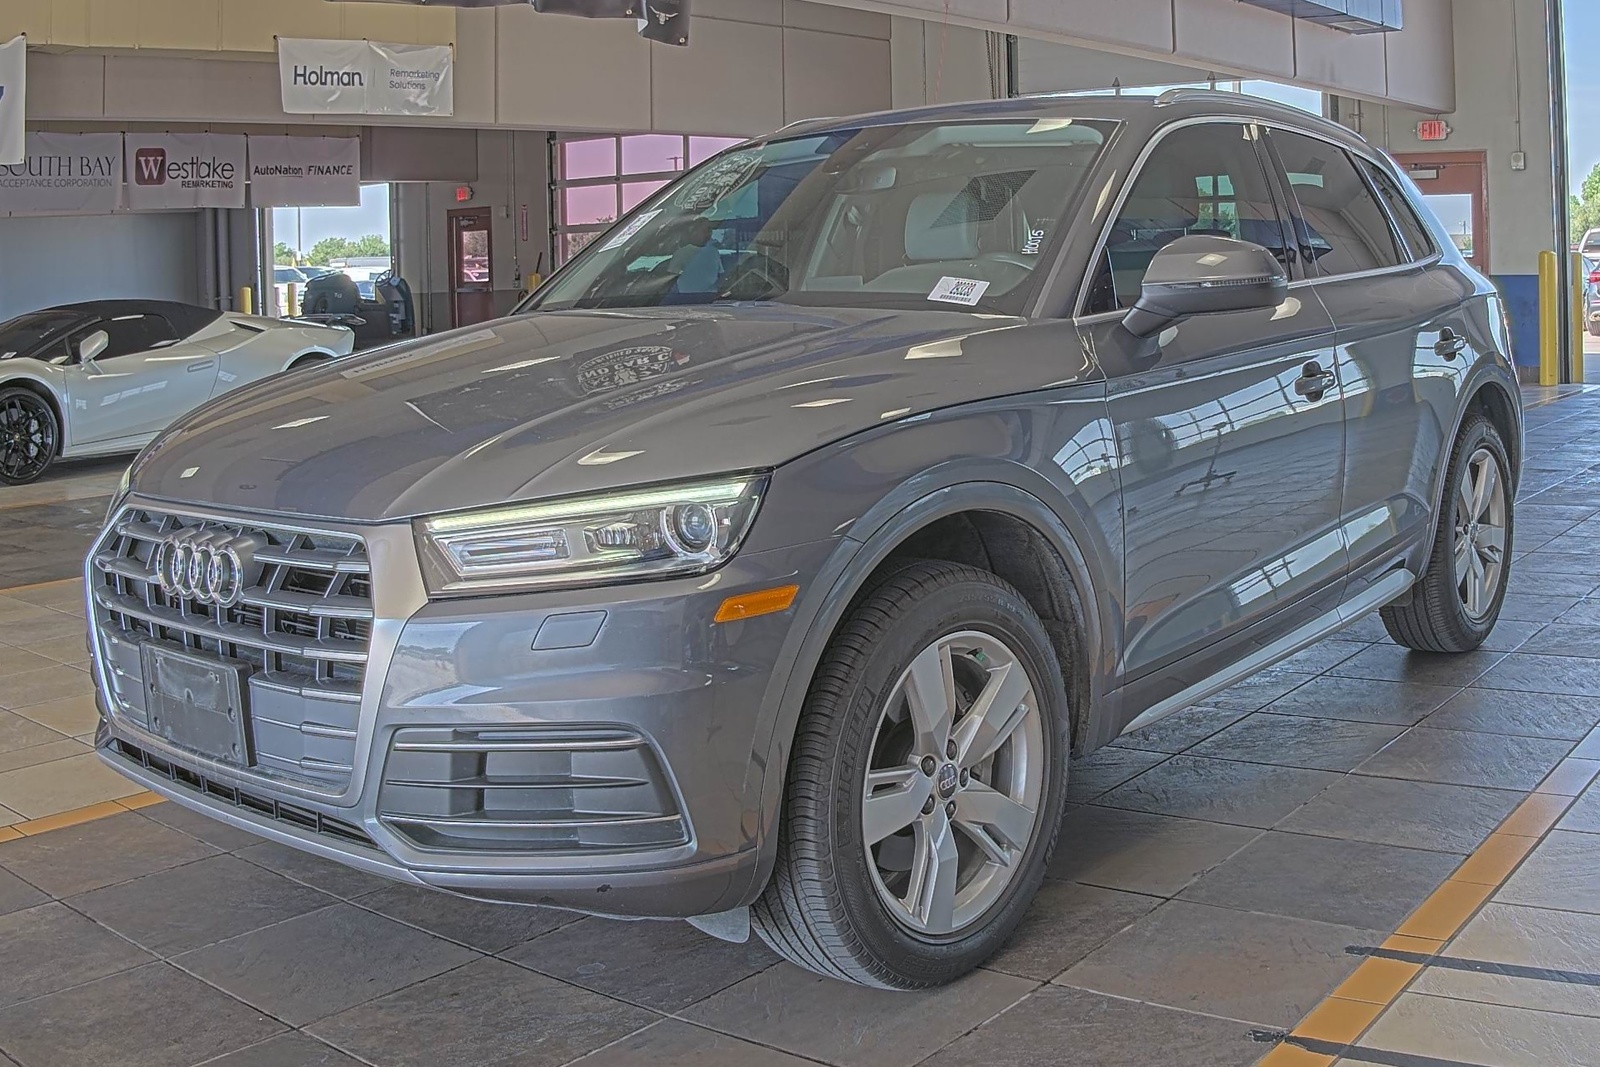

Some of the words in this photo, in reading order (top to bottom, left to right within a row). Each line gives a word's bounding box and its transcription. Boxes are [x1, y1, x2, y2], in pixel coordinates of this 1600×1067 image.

[293, 65, 364, 87] Holman
[390, 68, 440, 81] Remarketing
[389, 80, 426, 90] Solutions
[1421, 121, 1442, 139] EXIT
[80, 156, 116, 176] BAY
[138, 156, 235, 180] Westlake
[253, 165, 304, 176] AutoNation
[307, 165, 354, 176] FINANCE
[54, 178, 113, 188] CORPORATION
[181, 180, 234, 189] REMARKETING
